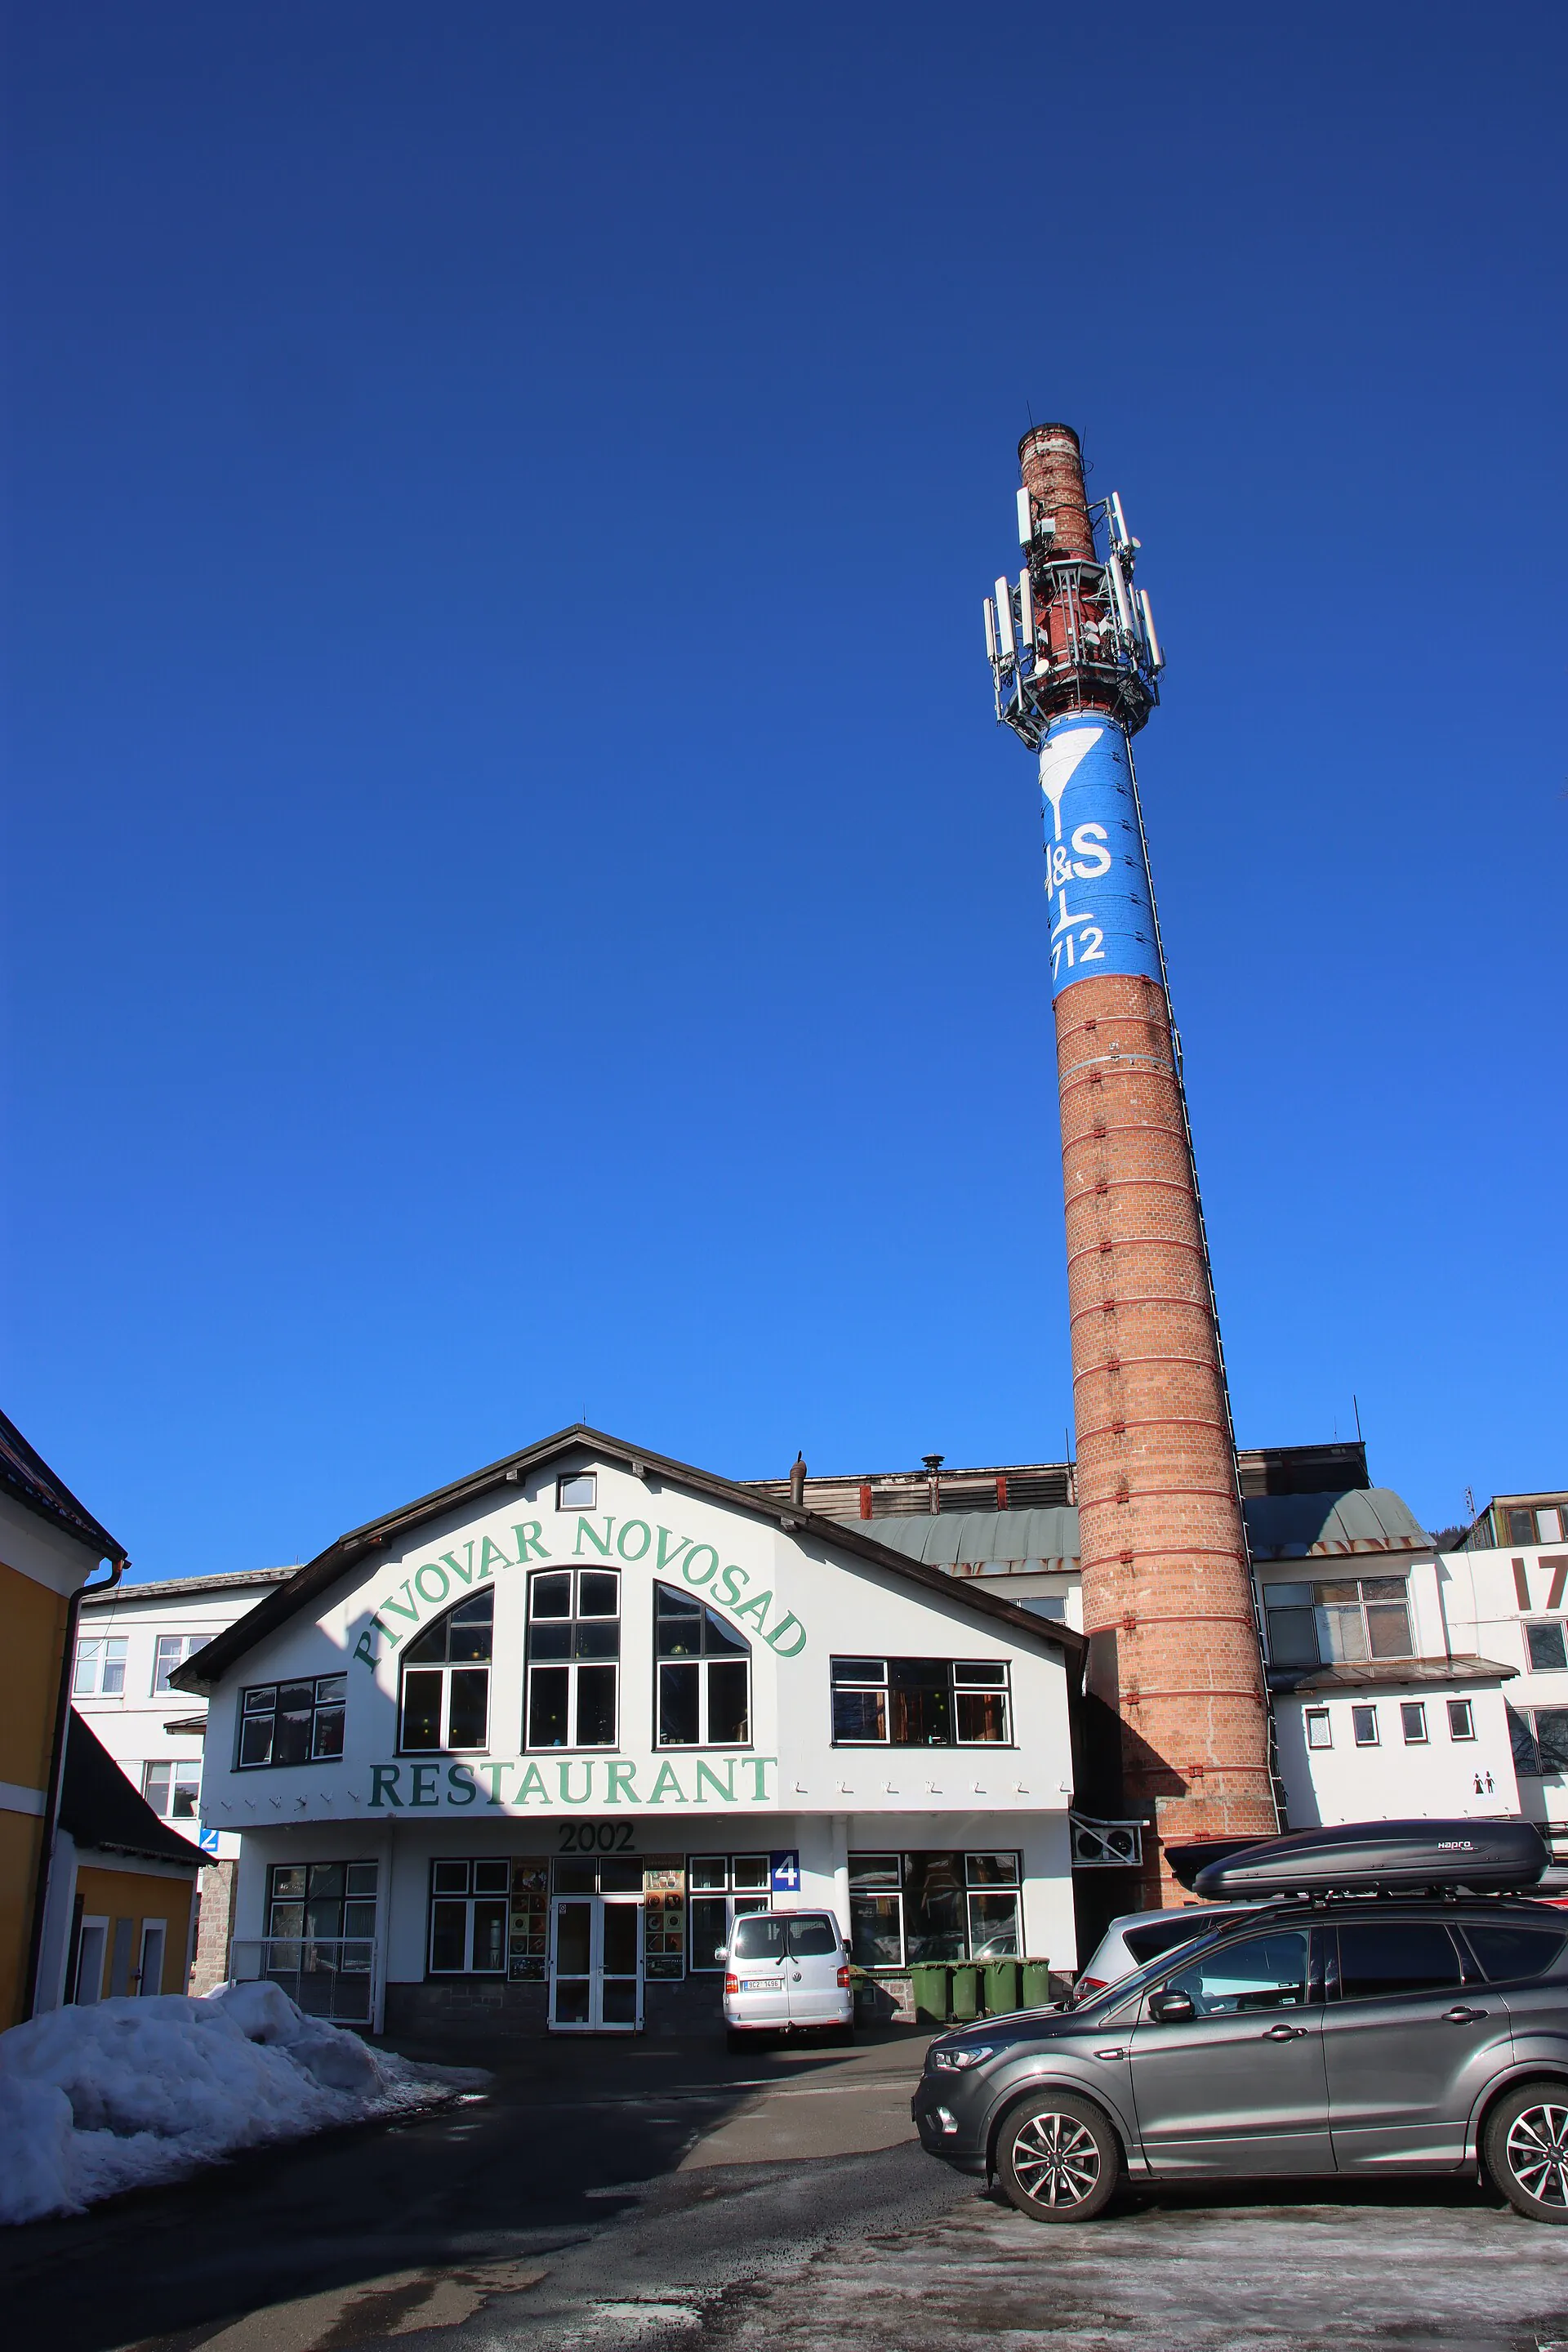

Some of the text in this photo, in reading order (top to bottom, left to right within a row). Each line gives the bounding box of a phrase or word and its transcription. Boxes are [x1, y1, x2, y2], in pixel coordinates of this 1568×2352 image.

[353, 1516, 807, 1674] PIVOVAR NOVOSAD
[368, 1757, 778, 1807] RESTAURANT
[200, 1829, 216, 1849] 2
[559, 1821, 635, 1852] 2002
[774, 1855, 799, 1886] 4
